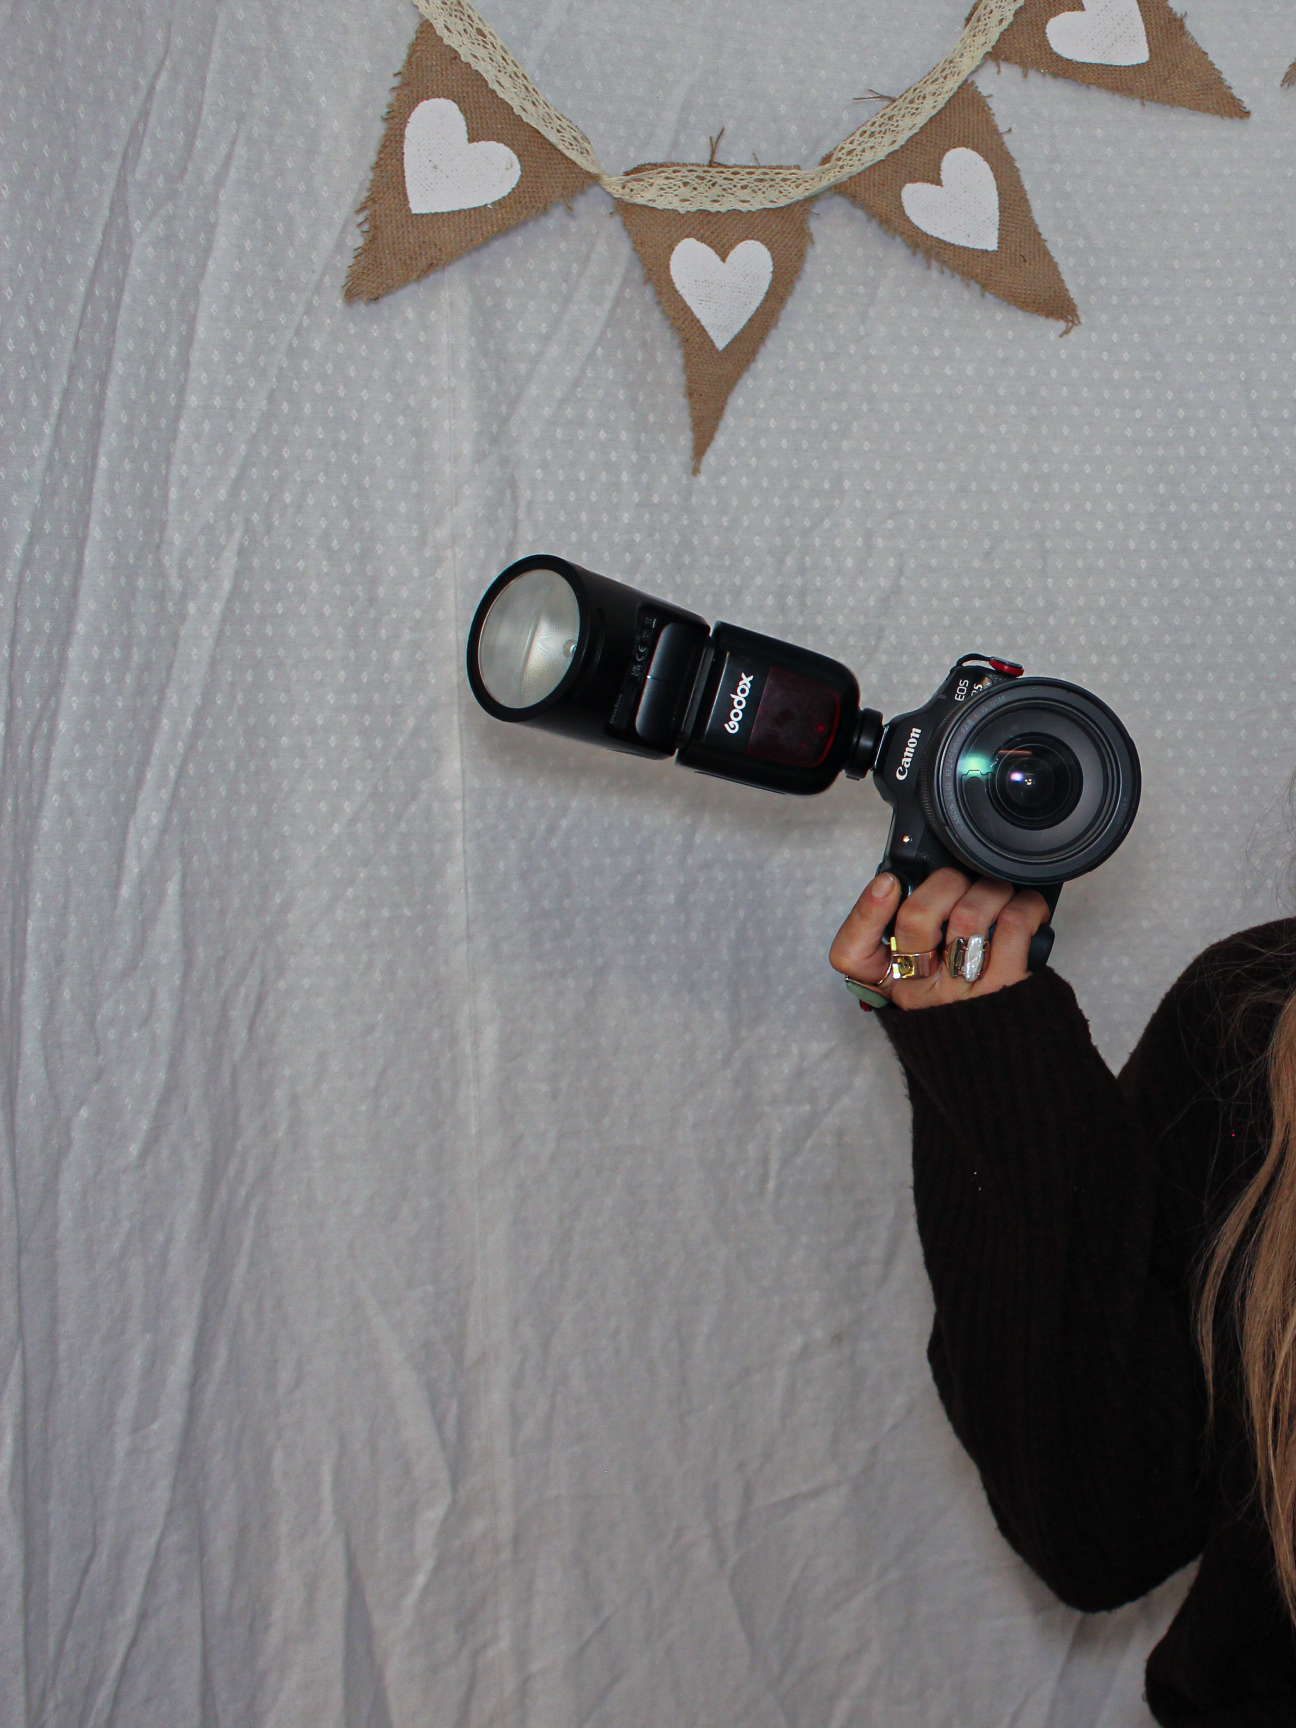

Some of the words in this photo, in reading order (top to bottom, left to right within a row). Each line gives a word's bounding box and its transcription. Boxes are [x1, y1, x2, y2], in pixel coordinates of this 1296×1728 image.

[723, 672, 754, 734] Godox
[954, 678, 969, 702] EOS
[895, 727, 922, 781] Canon
